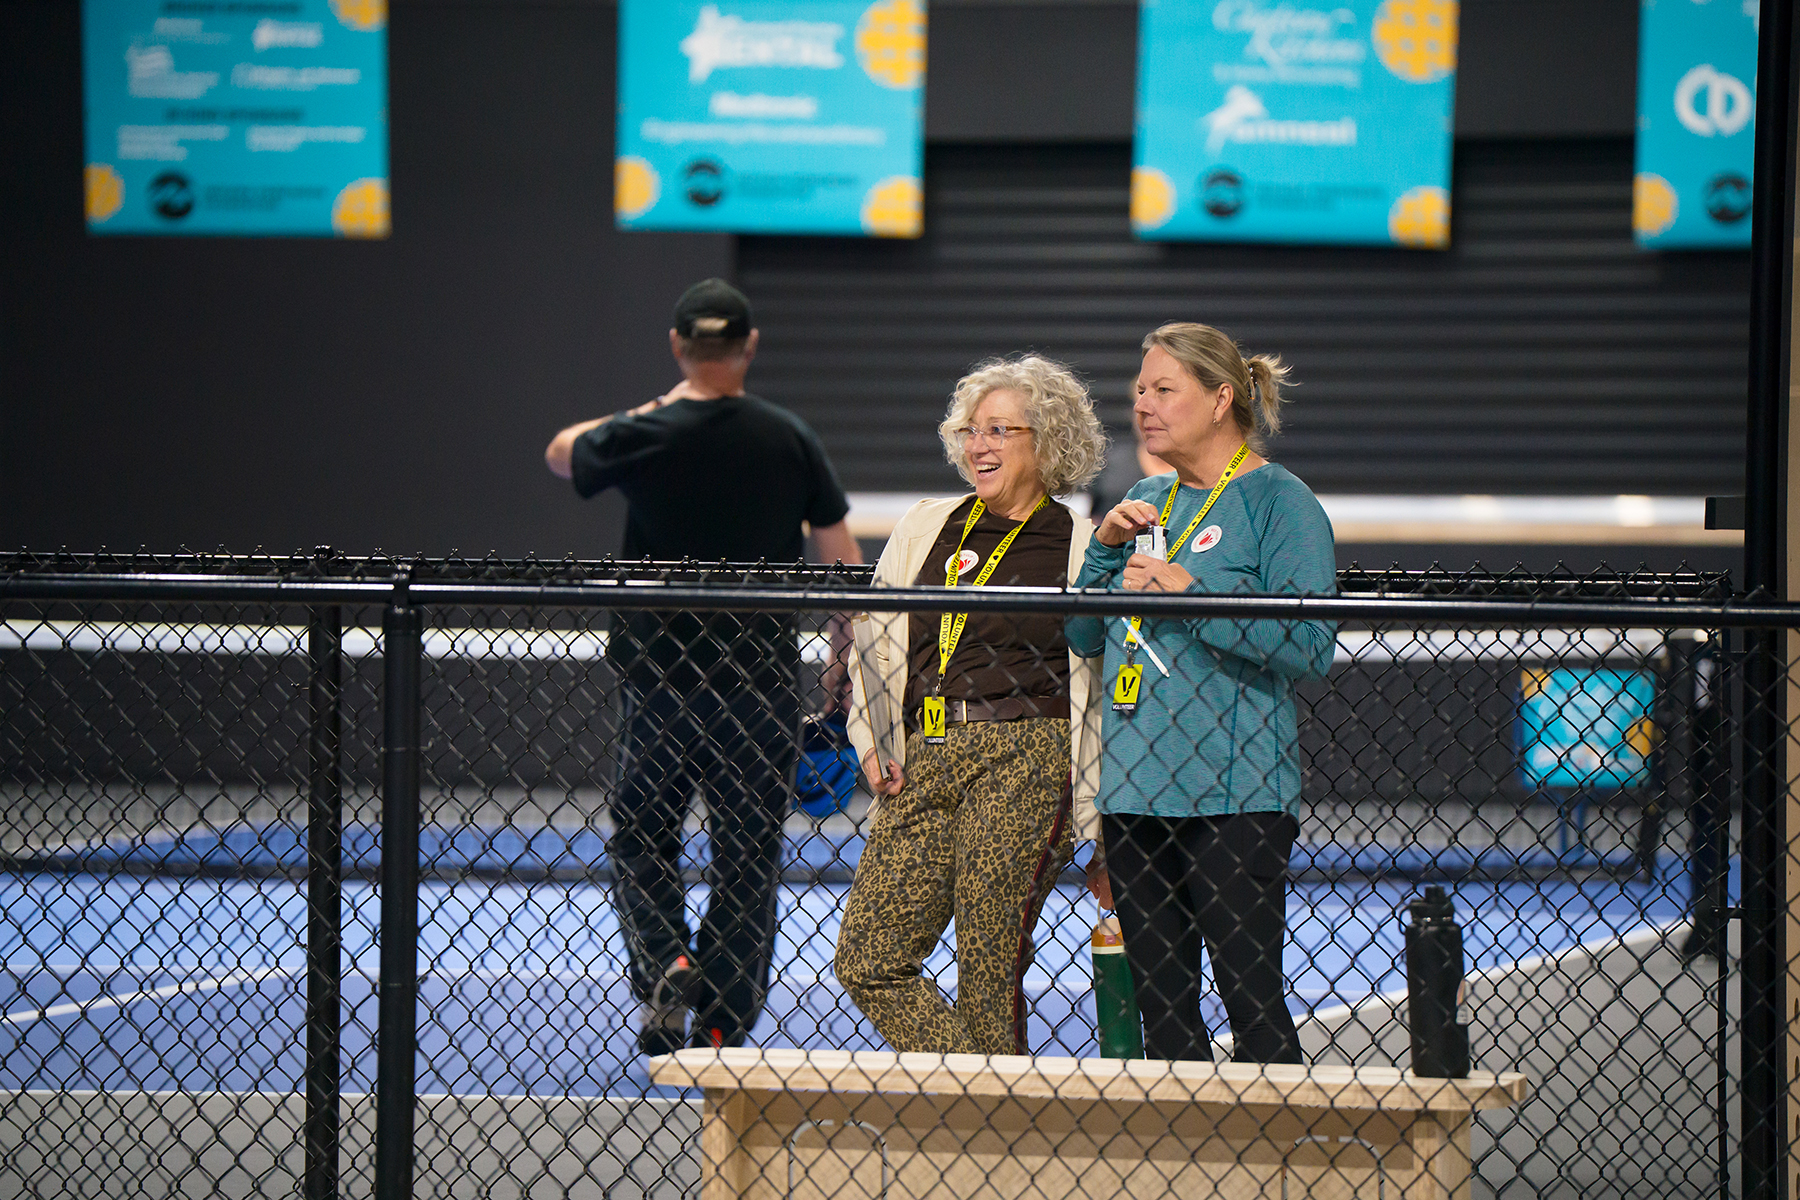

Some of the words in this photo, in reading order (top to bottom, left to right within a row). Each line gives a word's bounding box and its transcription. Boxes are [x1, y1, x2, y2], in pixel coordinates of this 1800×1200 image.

[1229, 443, 1249, 469] LUNTEER
[1197, 479, 1226, 519] VOLUNTEER
[996, 523, 1021, 554] LUNTEER
[1167, 528, 1191, 557] VOLUNTE
[947, 552, 961, 587] VOLUNTE
[974, 562, 995, 586] VOLUN
[941, 614, 950, 645] VOLUNT
